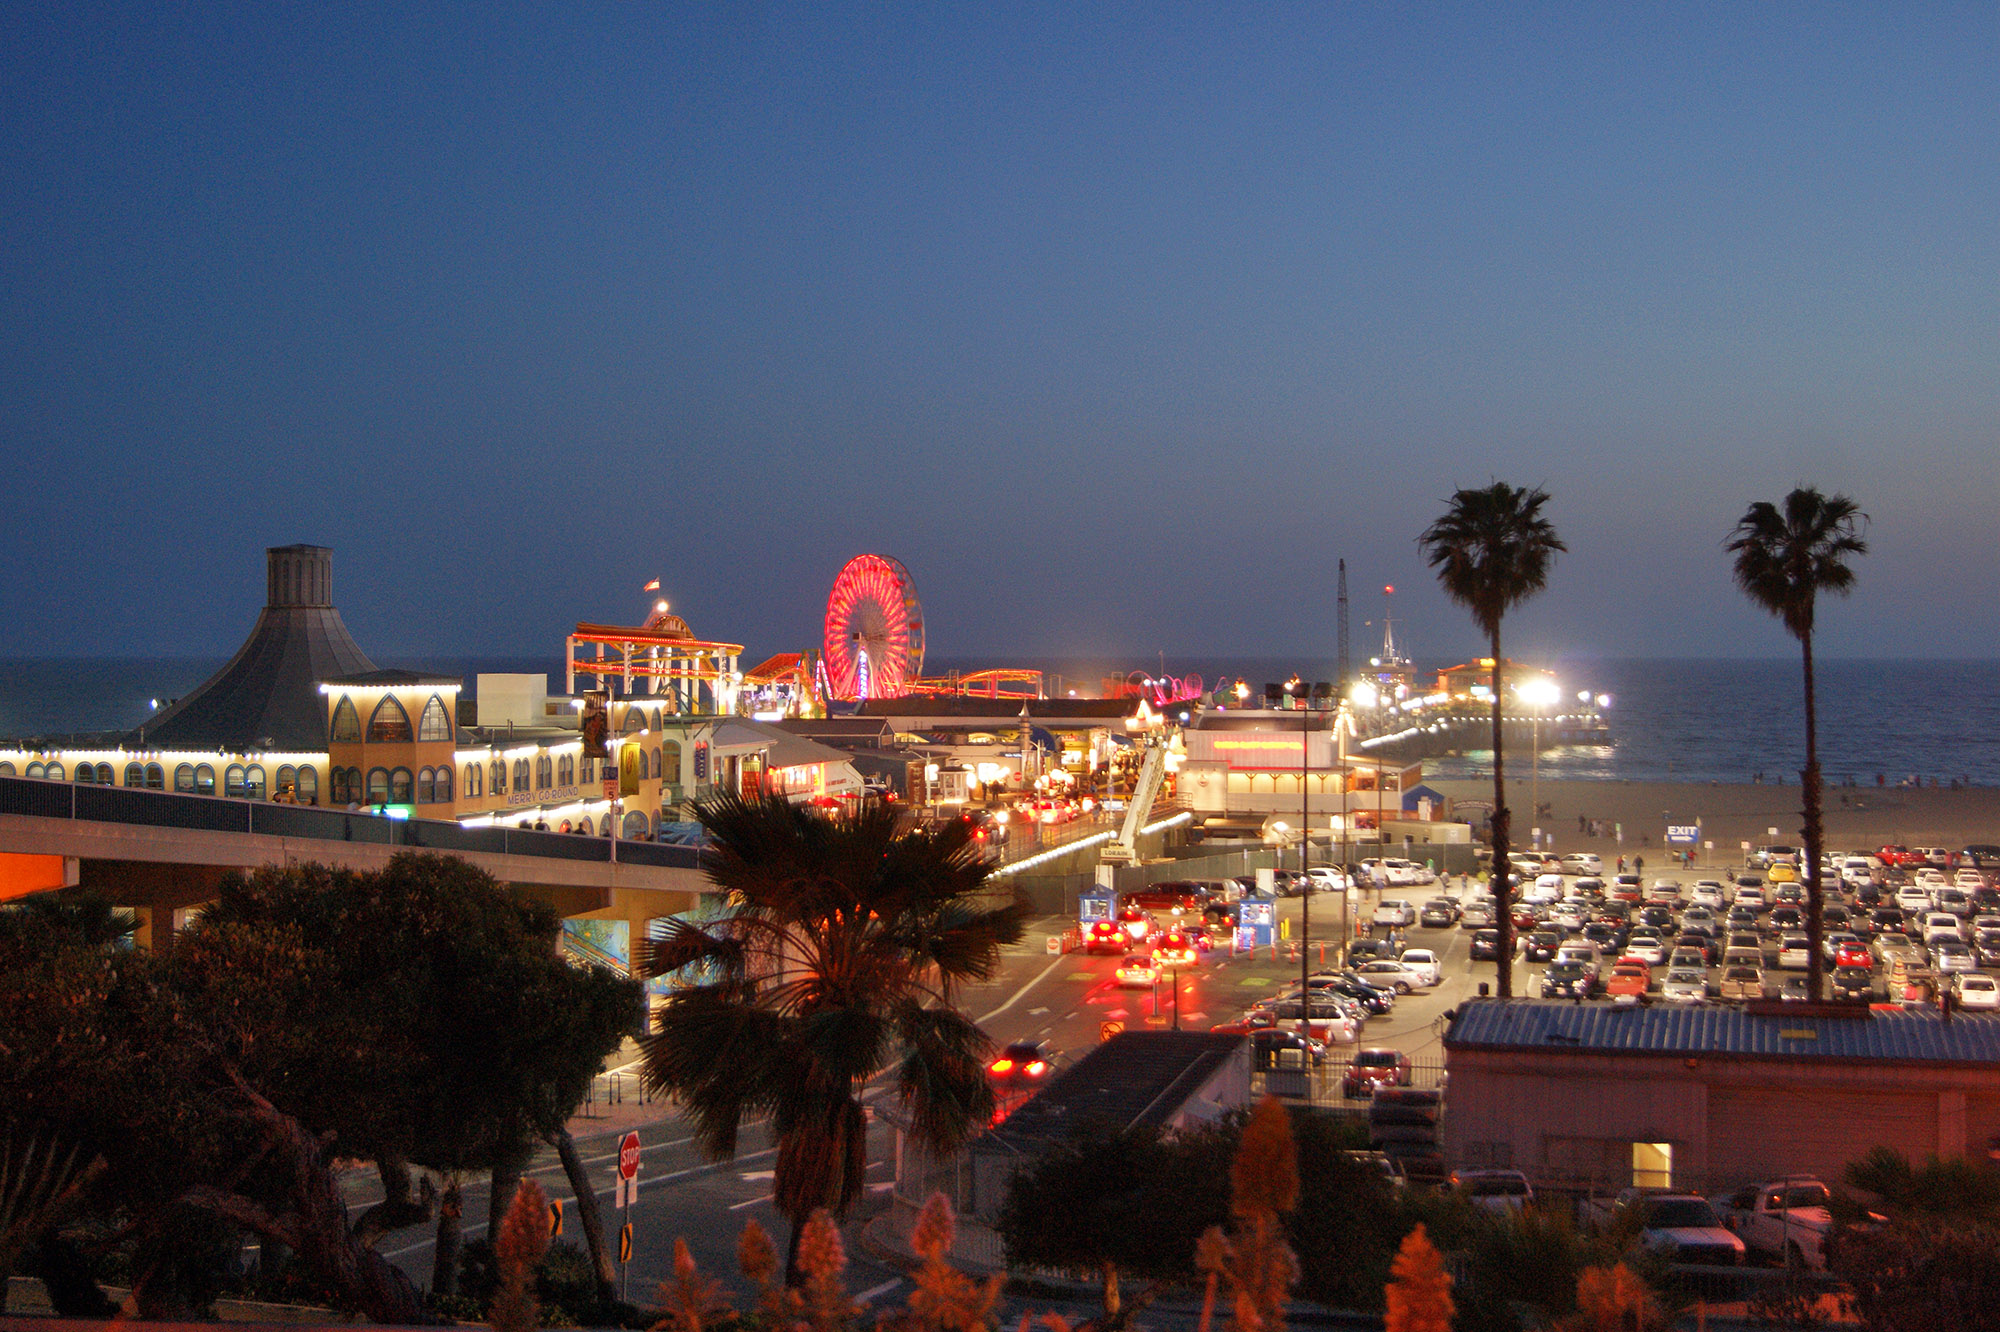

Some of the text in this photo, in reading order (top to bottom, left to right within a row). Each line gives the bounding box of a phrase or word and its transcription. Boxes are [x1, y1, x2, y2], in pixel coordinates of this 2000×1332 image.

[508, 792, 536, 805] MERRY
[608, 791, 615, 799] 5
[1667, 825, 1698, 835] EXIT
[622, 1146, 640, 1167] STOP
